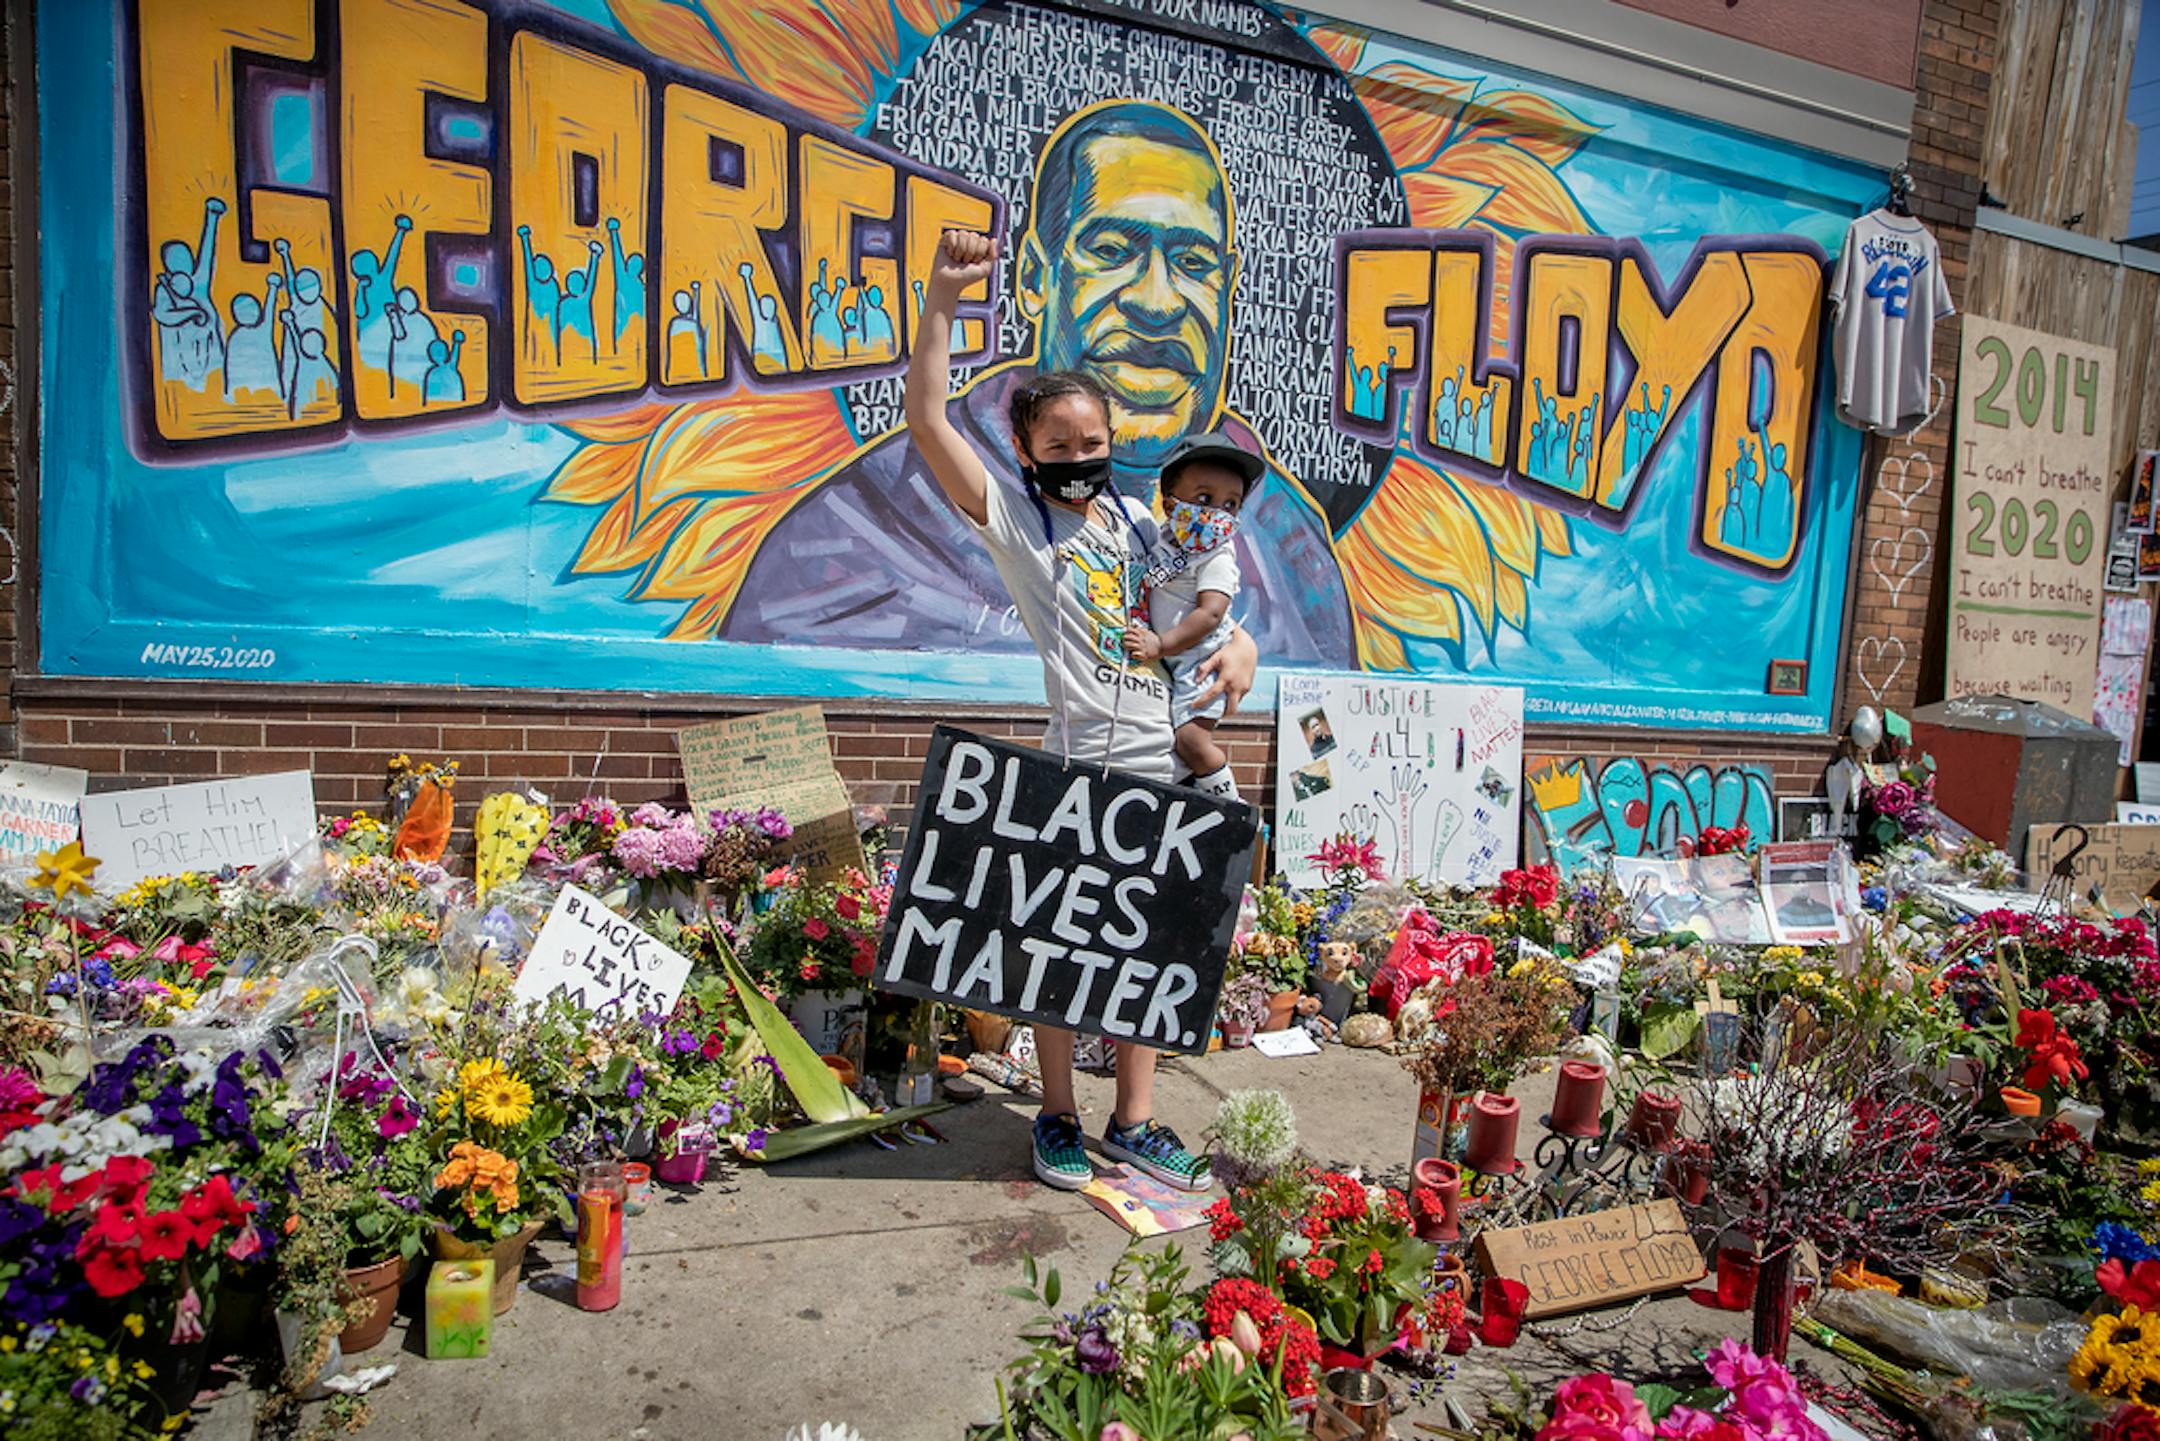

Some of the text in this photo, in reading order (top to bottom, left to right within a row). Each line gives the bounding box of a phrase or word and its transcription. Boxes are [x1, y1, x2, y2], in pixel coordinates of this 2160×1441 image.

[1005, 1, 1123, 53] TERRENCE
[927, 35, 978, 69] AKAI
[973, 19, 1045, 58] TAMIR
[1049, 37, 1104, 76] RICE
[1125, 52, 1237, 100] PHILANDO
[914, 56, 1017, 99] MICHAEL
[896, 78, 1061, 134] TYISHA MILLE
[1218, 99, 1297, 137] FREDDIE
[876, 102, 1035, 158] ERIC GARNER
[892, 131, 987, 174] SANDRA
[1229, 169, 1313, 209] SHANTEL
[1233, 195, 1311, 234] WALTER
[1233, 221, 1289, 254] REKIA
[137, 0, 1825, 572] GEORGE FLOYD
[1235, 271, 1307, 310] SHELLY
[1865, 260, 1911, 320] 42
[1232, 333, 1316, 371] TANISHA
[1226, 383, 1291, 422] ALTON
[1974, 335, 2100, 436] 2014
[1963, 440, 2102, 493] I can't breathe
[1966, 491, 2094, 566] 2020
[1959, 569, 2094, 606] I can't breathe
[1956, 614, 2089, 656] People are angry
[1094, 664, 1164, 700] GAME
[1347, 683, 1436, 718] JUSTICE
[1954, 673, 2074, 705] because waiting
[1, 811, 72, 841] GARNER
[115, 793, 174, 828] Let
[936, 741, 1225, 881] BLACK
[132, 817, 285, 870] BREATHE!
[2037, 831, 2108, 887] Hitory
[910, 829, 1158, 951] LIVES
[566, 897, 650, 971] BLACK
[582, 945, 667, 1016] LIVES
[884, 905, 1198, 1048] MATTER.
[1522, 1220, 1628, 1250] Rest in Power
[1519, 1240, 1696, 1304] GEORGE FLOYD
